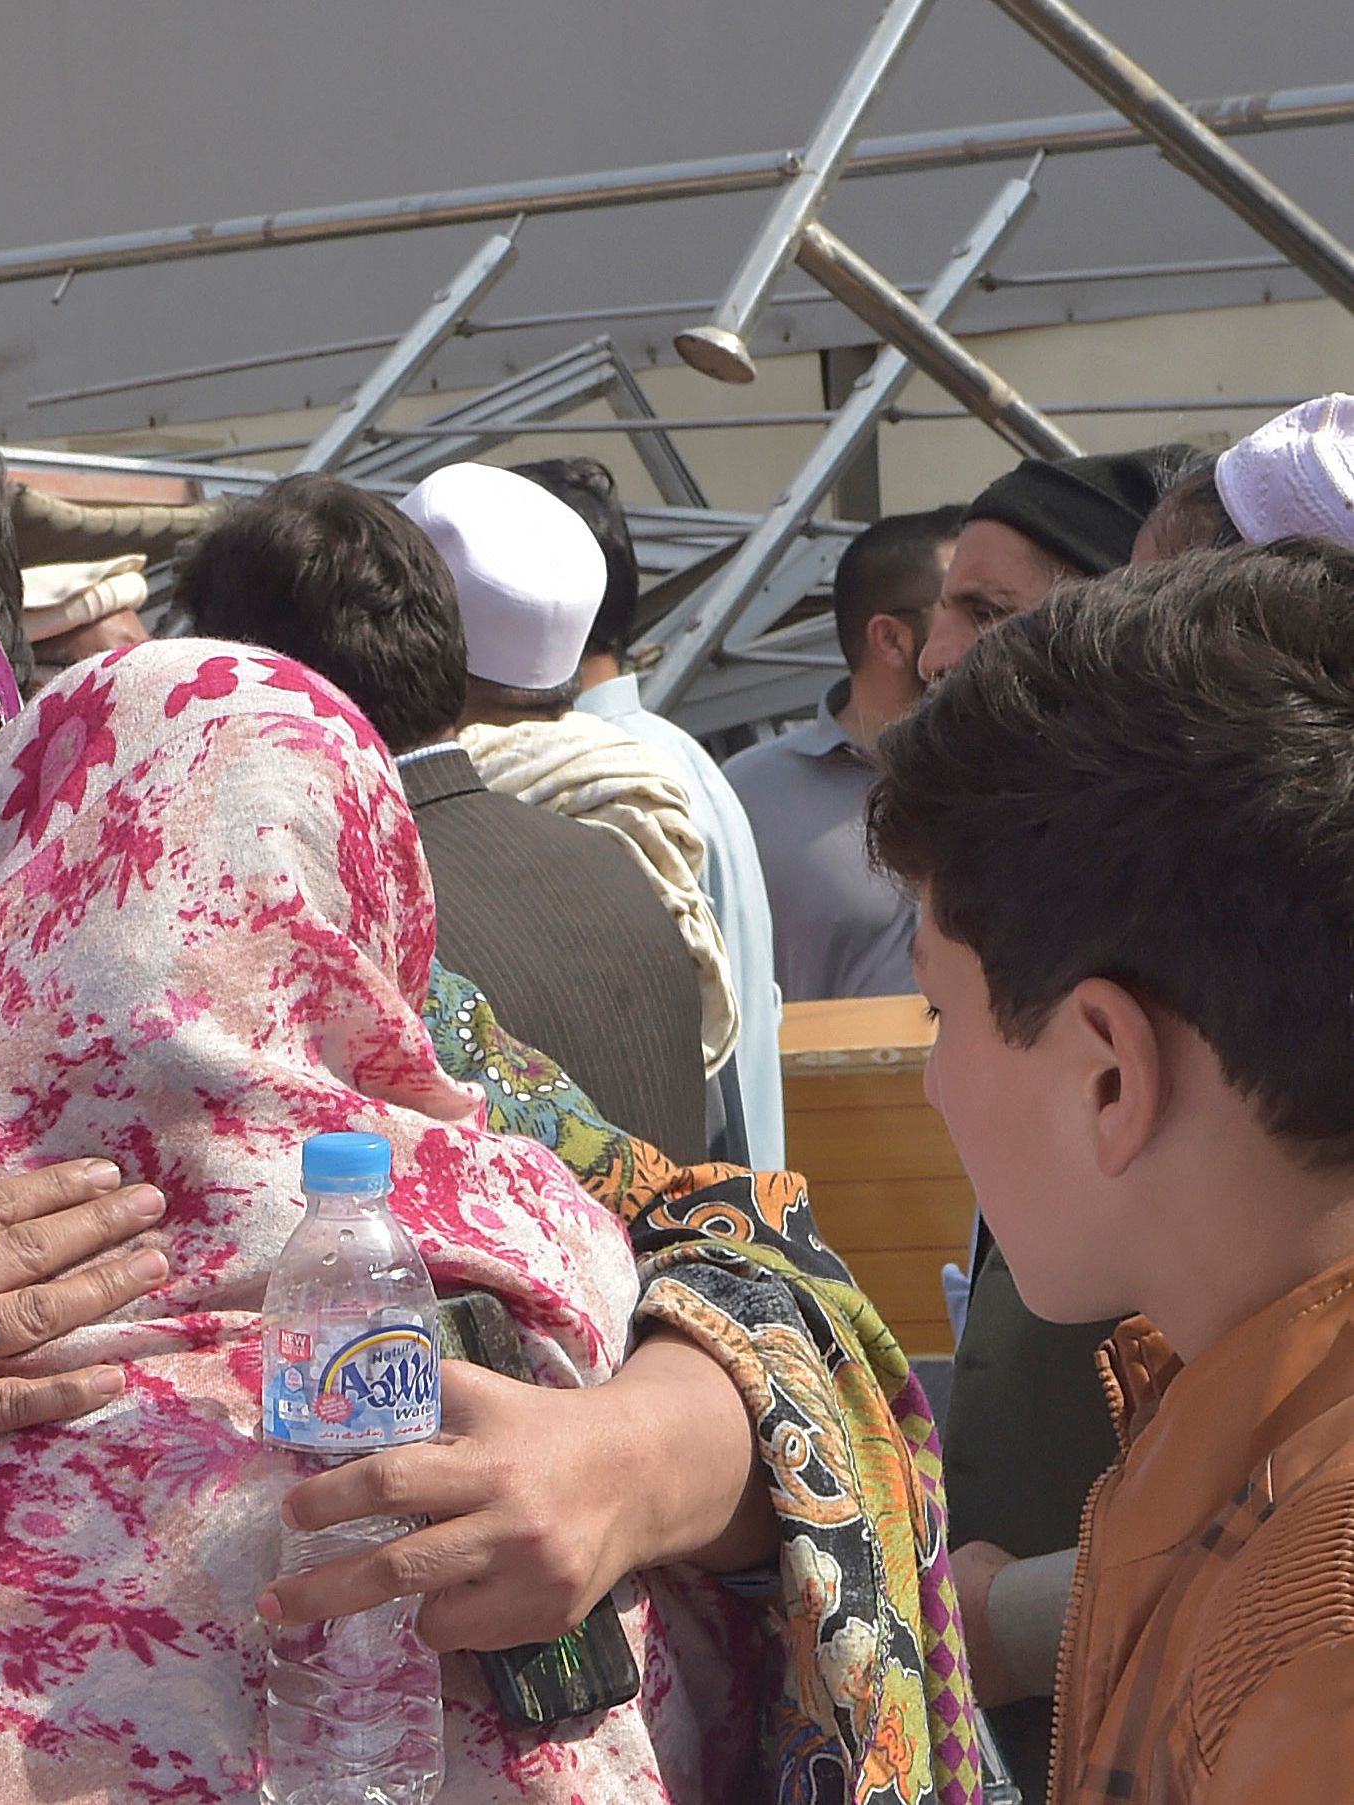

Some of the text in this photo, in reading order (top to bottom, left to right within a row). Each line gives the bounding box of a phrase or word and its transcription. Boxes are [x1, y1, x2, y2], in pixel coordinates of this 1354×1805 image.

[281, 1330, 307, 1346] NEW
[372, 1333, 421, 1364] Natural
[395, 1401, 433, 1420] Water
